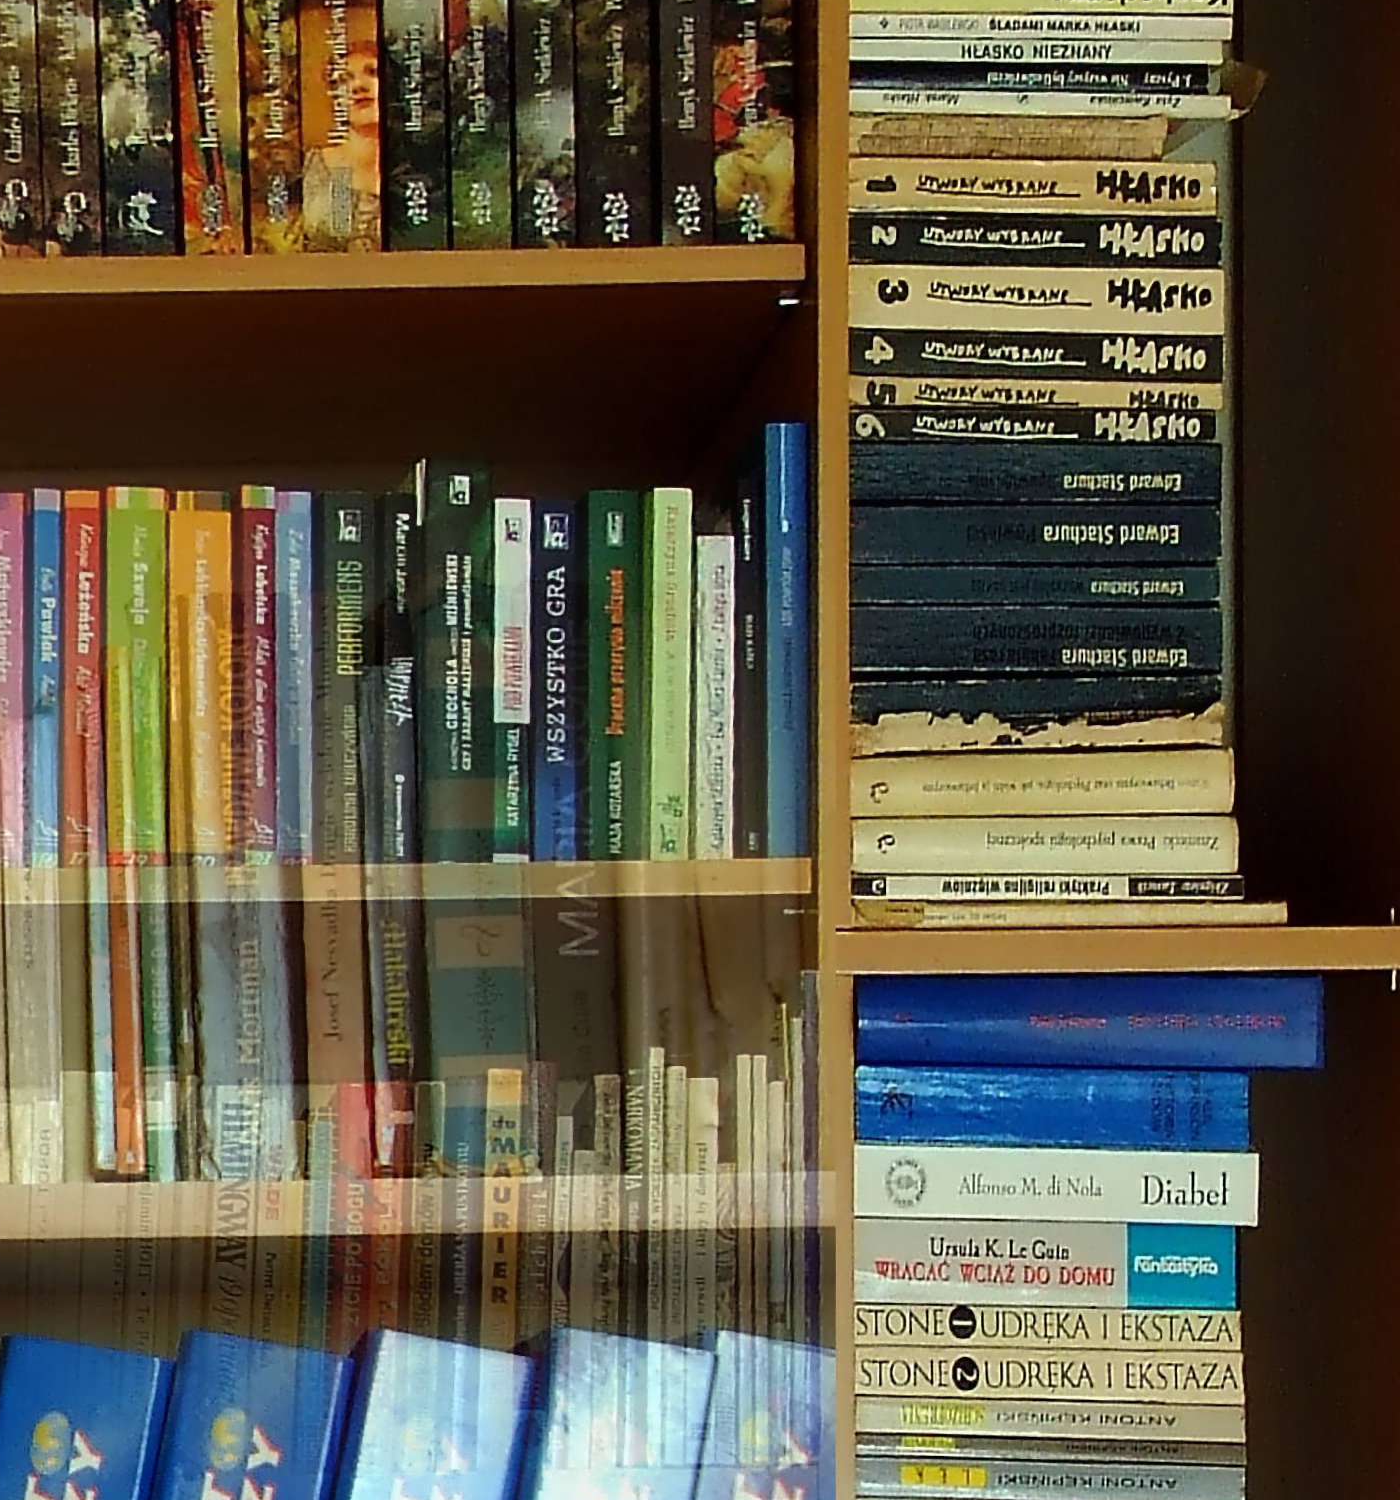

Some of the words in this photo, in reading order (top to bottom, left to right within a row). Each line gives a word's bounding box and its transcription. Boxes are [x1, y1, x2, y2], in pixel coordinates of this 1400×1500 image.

[960, 44, 1024, 60] HŁASKO
[1033, 44, 1112, 60] NIEZNANY
[879, 280, 908, 304] 3
[1043, 525, 1113, 543] Stachura
[1120, 525, 1180, 545] Edward
[958, 1175, 1016, 1197] Alfonso
[1021, 1177, 1043, 1196] M.
[1047, 1176, 1062, 1196] di
[1067, 1176, 1102, 1197] Nola
[1142, 1171, 1229, 1207] Diabeł
[929, 1237, 981, 1256] Ursula
[985, 1239, 1005, 1258] K.
[1009, 1241, 1027, 1258] Le
[1032, 1241, 1069, 1260] Guin
[875, 1257, 951, 1282] WRACAĆ
[959, 1260, 1015, 1286] WCIĄŻ
[1023, 1265, 1050, 1284] DO
[1059, 1265, 1115, 1286] DOMU
[856, 1311, 945, 1338] STONE
[980, 1311, 1089, 1344] UDRĘKA
[1121, 1314, 1233, 1343] EKSTAZA
